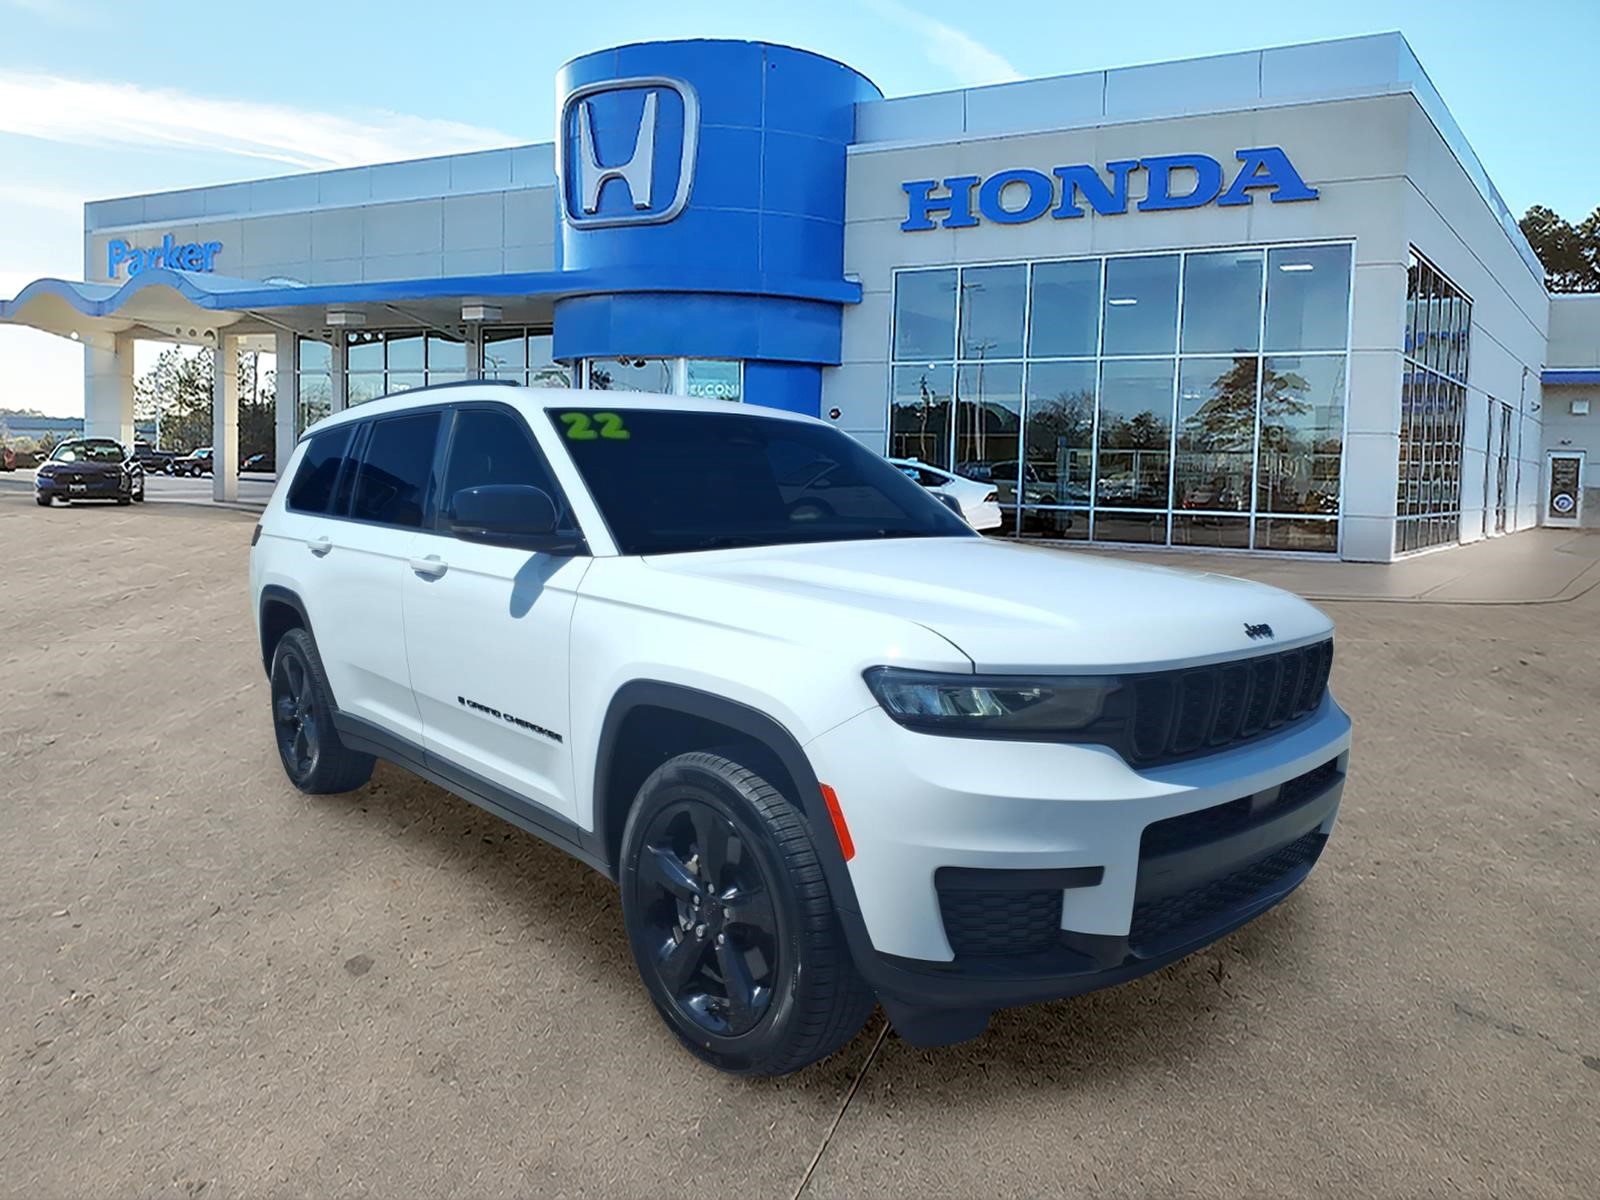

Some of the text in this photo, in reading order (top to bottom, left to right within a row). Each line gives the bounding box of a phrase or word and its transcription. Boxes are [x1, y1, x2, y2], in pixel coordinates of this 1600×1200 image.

[901, 146, 1320, 232] HONDA
[107, 233, 222, 279] Parker
[560, 411, 630, 440] 22
